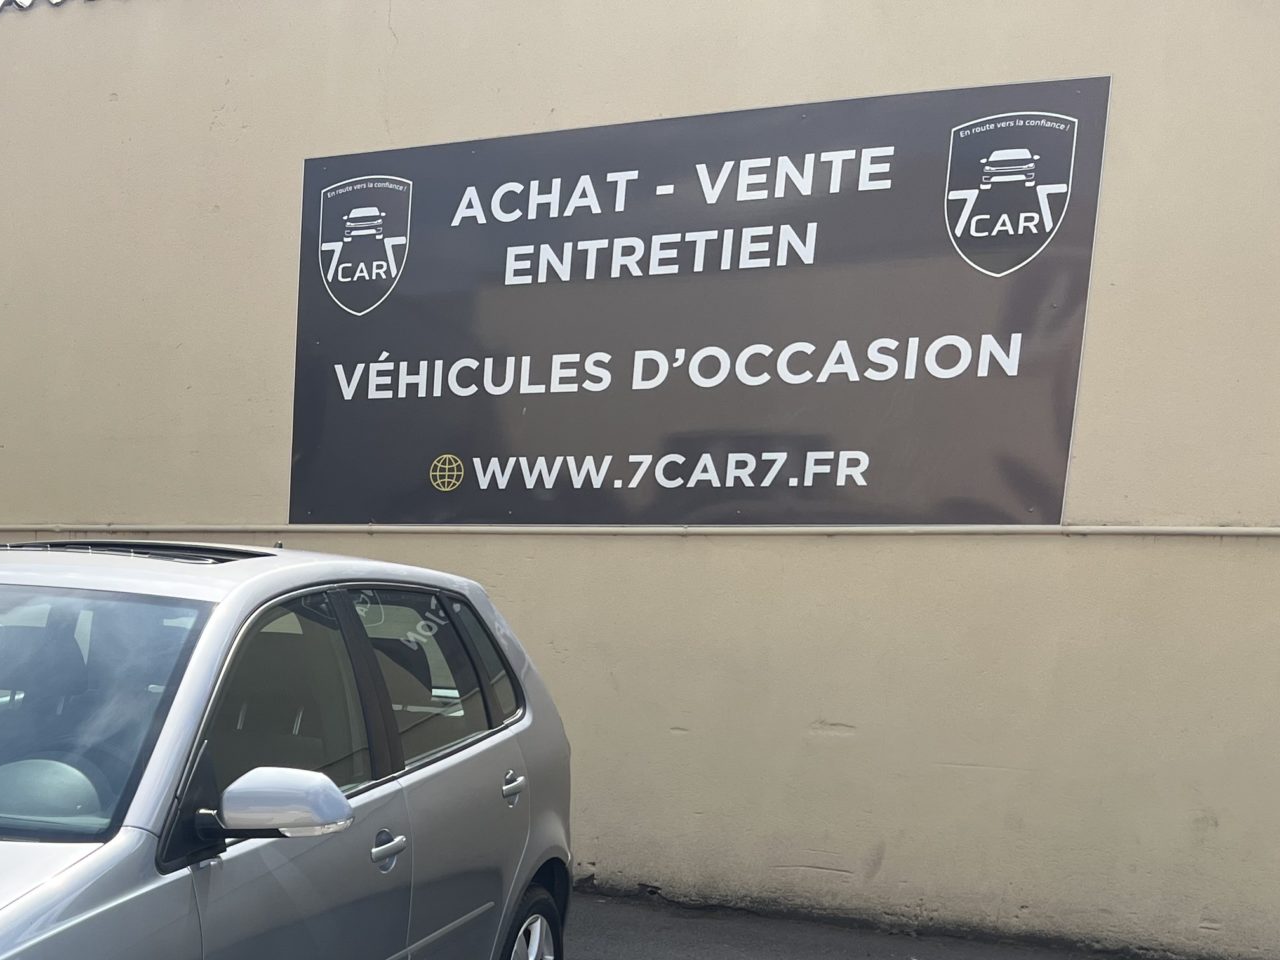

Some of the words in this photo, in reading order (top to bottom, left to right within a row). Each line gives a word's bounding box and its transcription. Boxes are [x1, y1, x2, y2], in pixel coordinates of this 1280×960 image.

[960, 130, 970, 138] En
[972, 123, 995, 133] route
[997, 120, 1014, 128] vers
[1025, 119, 1065, 131] confiance
[336, 186, 353, 195] route
[374, 182, 403, 191] confiance
[451, 170, 638, 226] ACHAT
[696, 146, 895, 204] VENTE
[504, 222, 818, 286] ENTRETIEN
[334, 351, 612, 400] VÉHICULES
[632, 333, 1022, 390] D’OCCASION
[472, 450, 870, 489] WWW.7CAR7.FR
